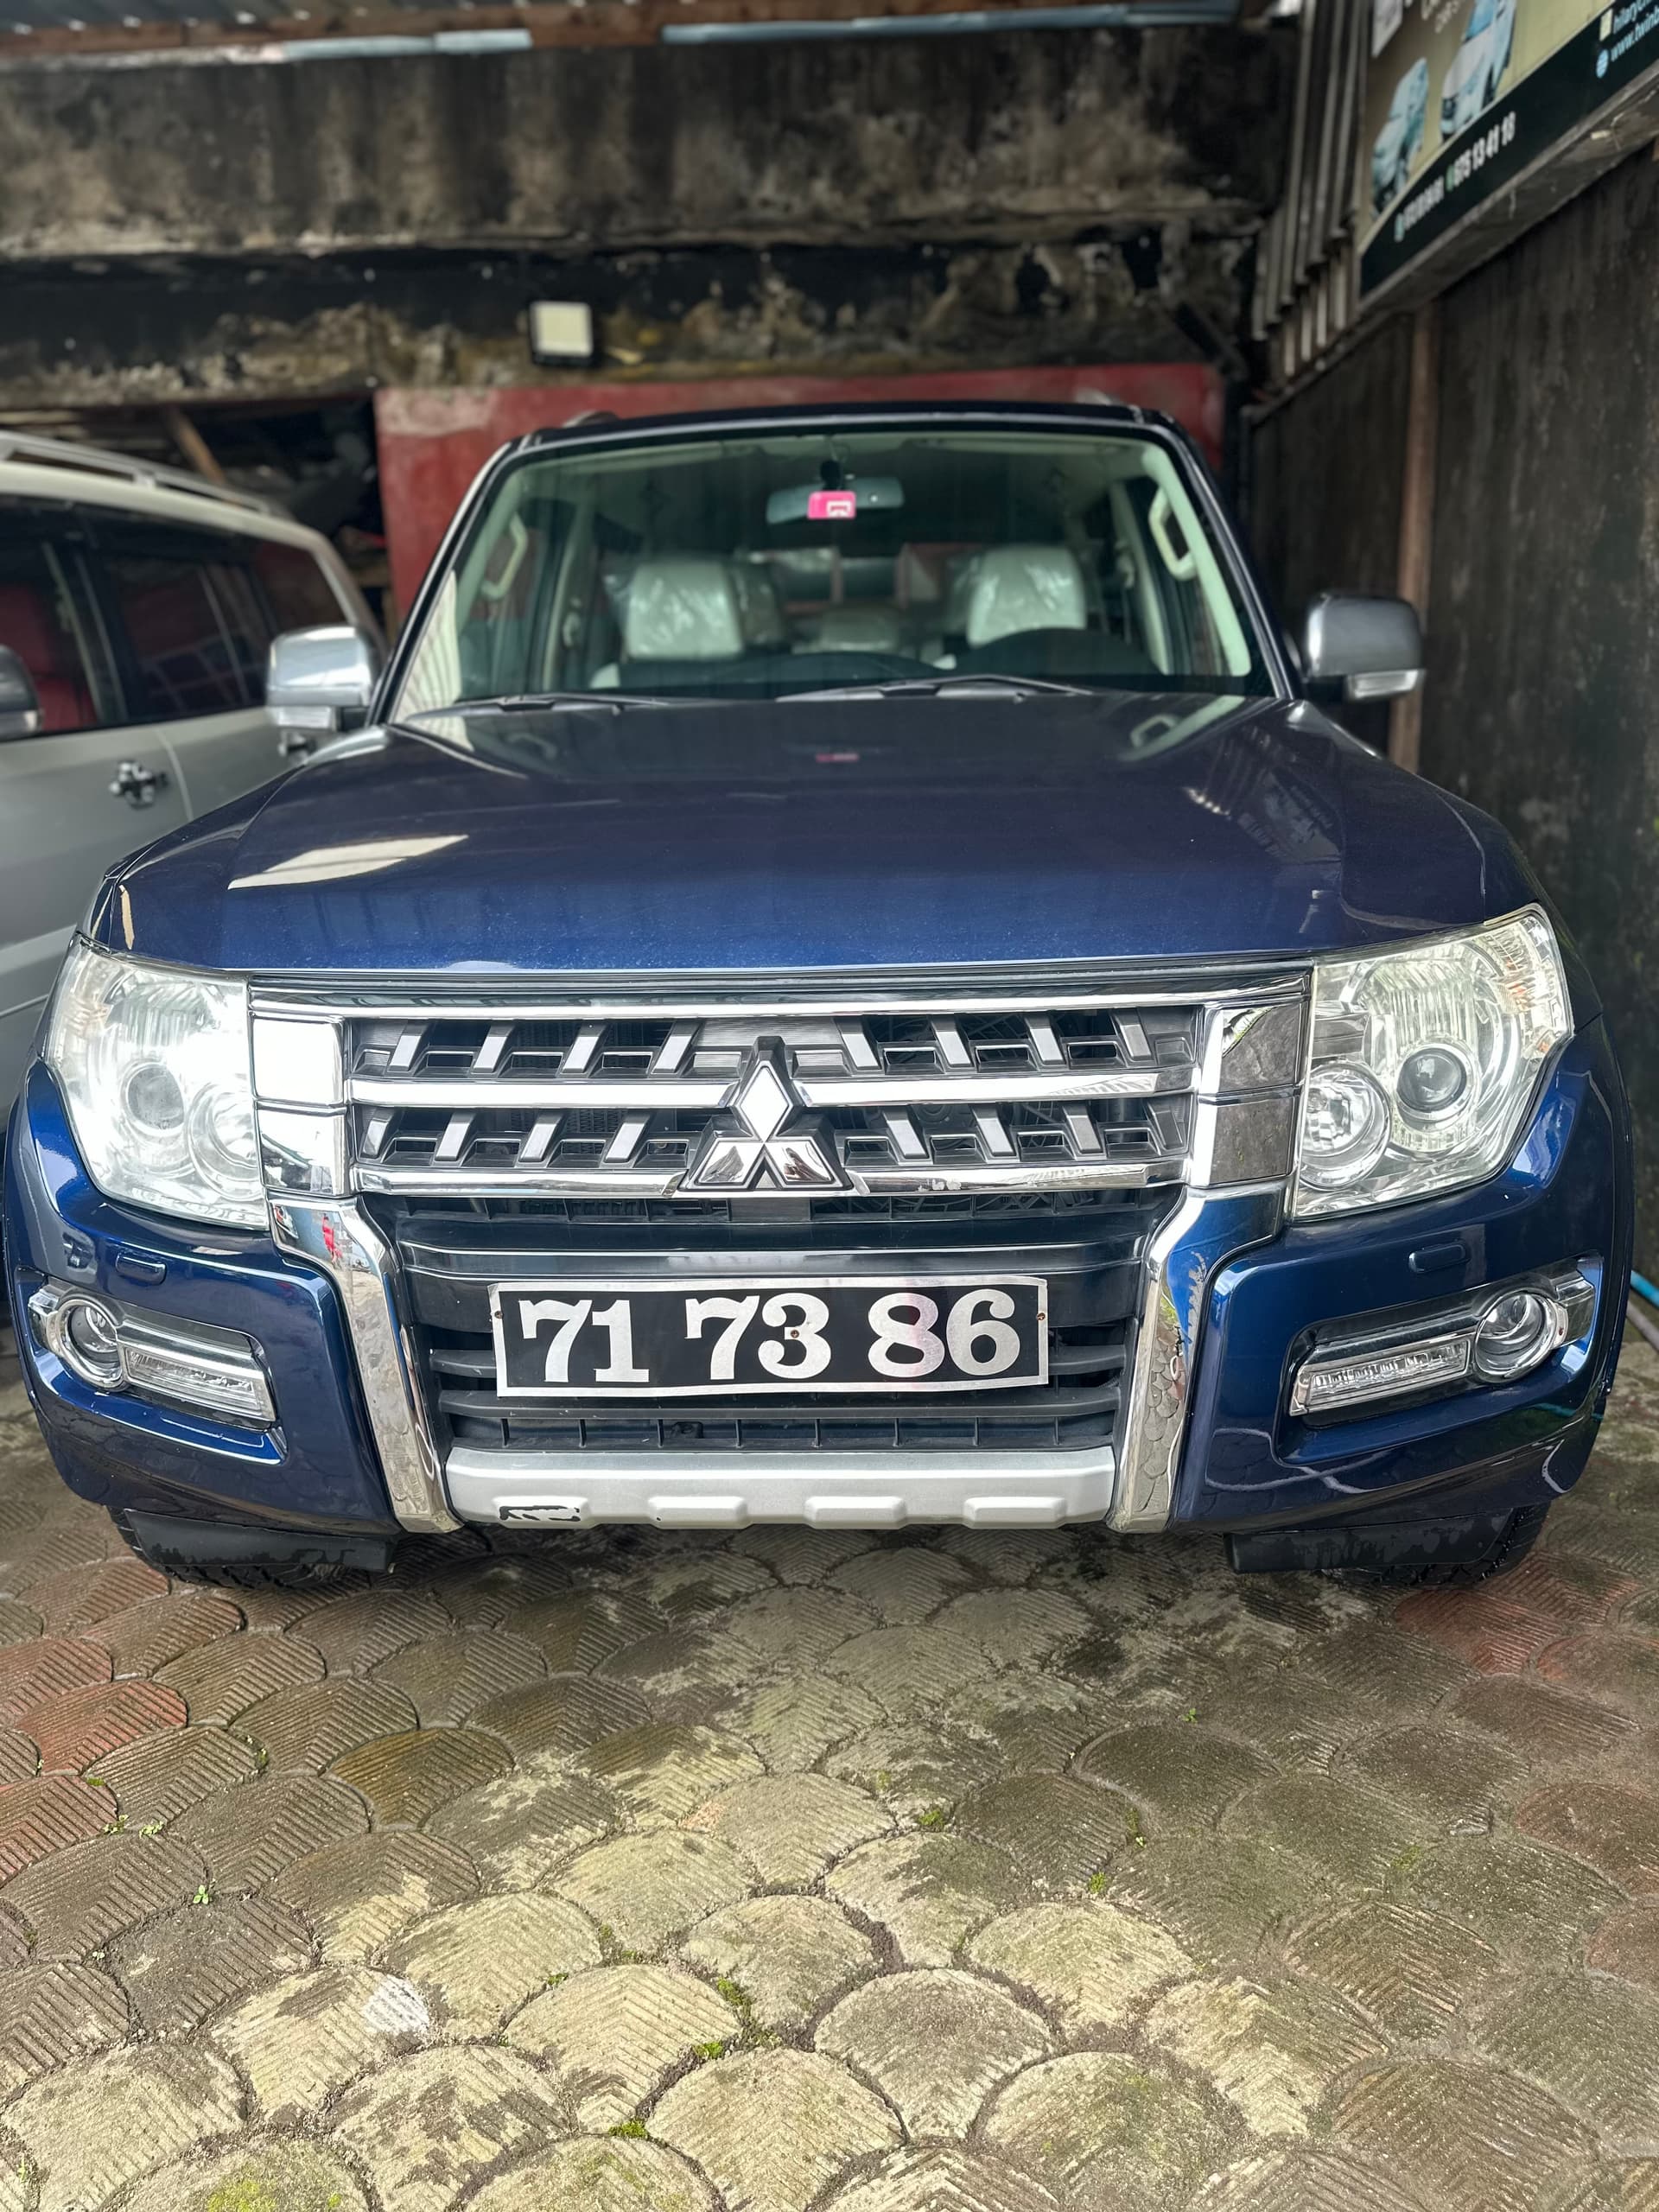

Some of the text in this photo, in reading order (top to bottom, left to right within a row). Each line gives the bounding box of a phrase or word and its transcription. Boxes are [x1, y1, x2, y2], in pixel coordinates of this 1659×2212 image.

[518, 1288, 1020, 1383] 71 73 86
